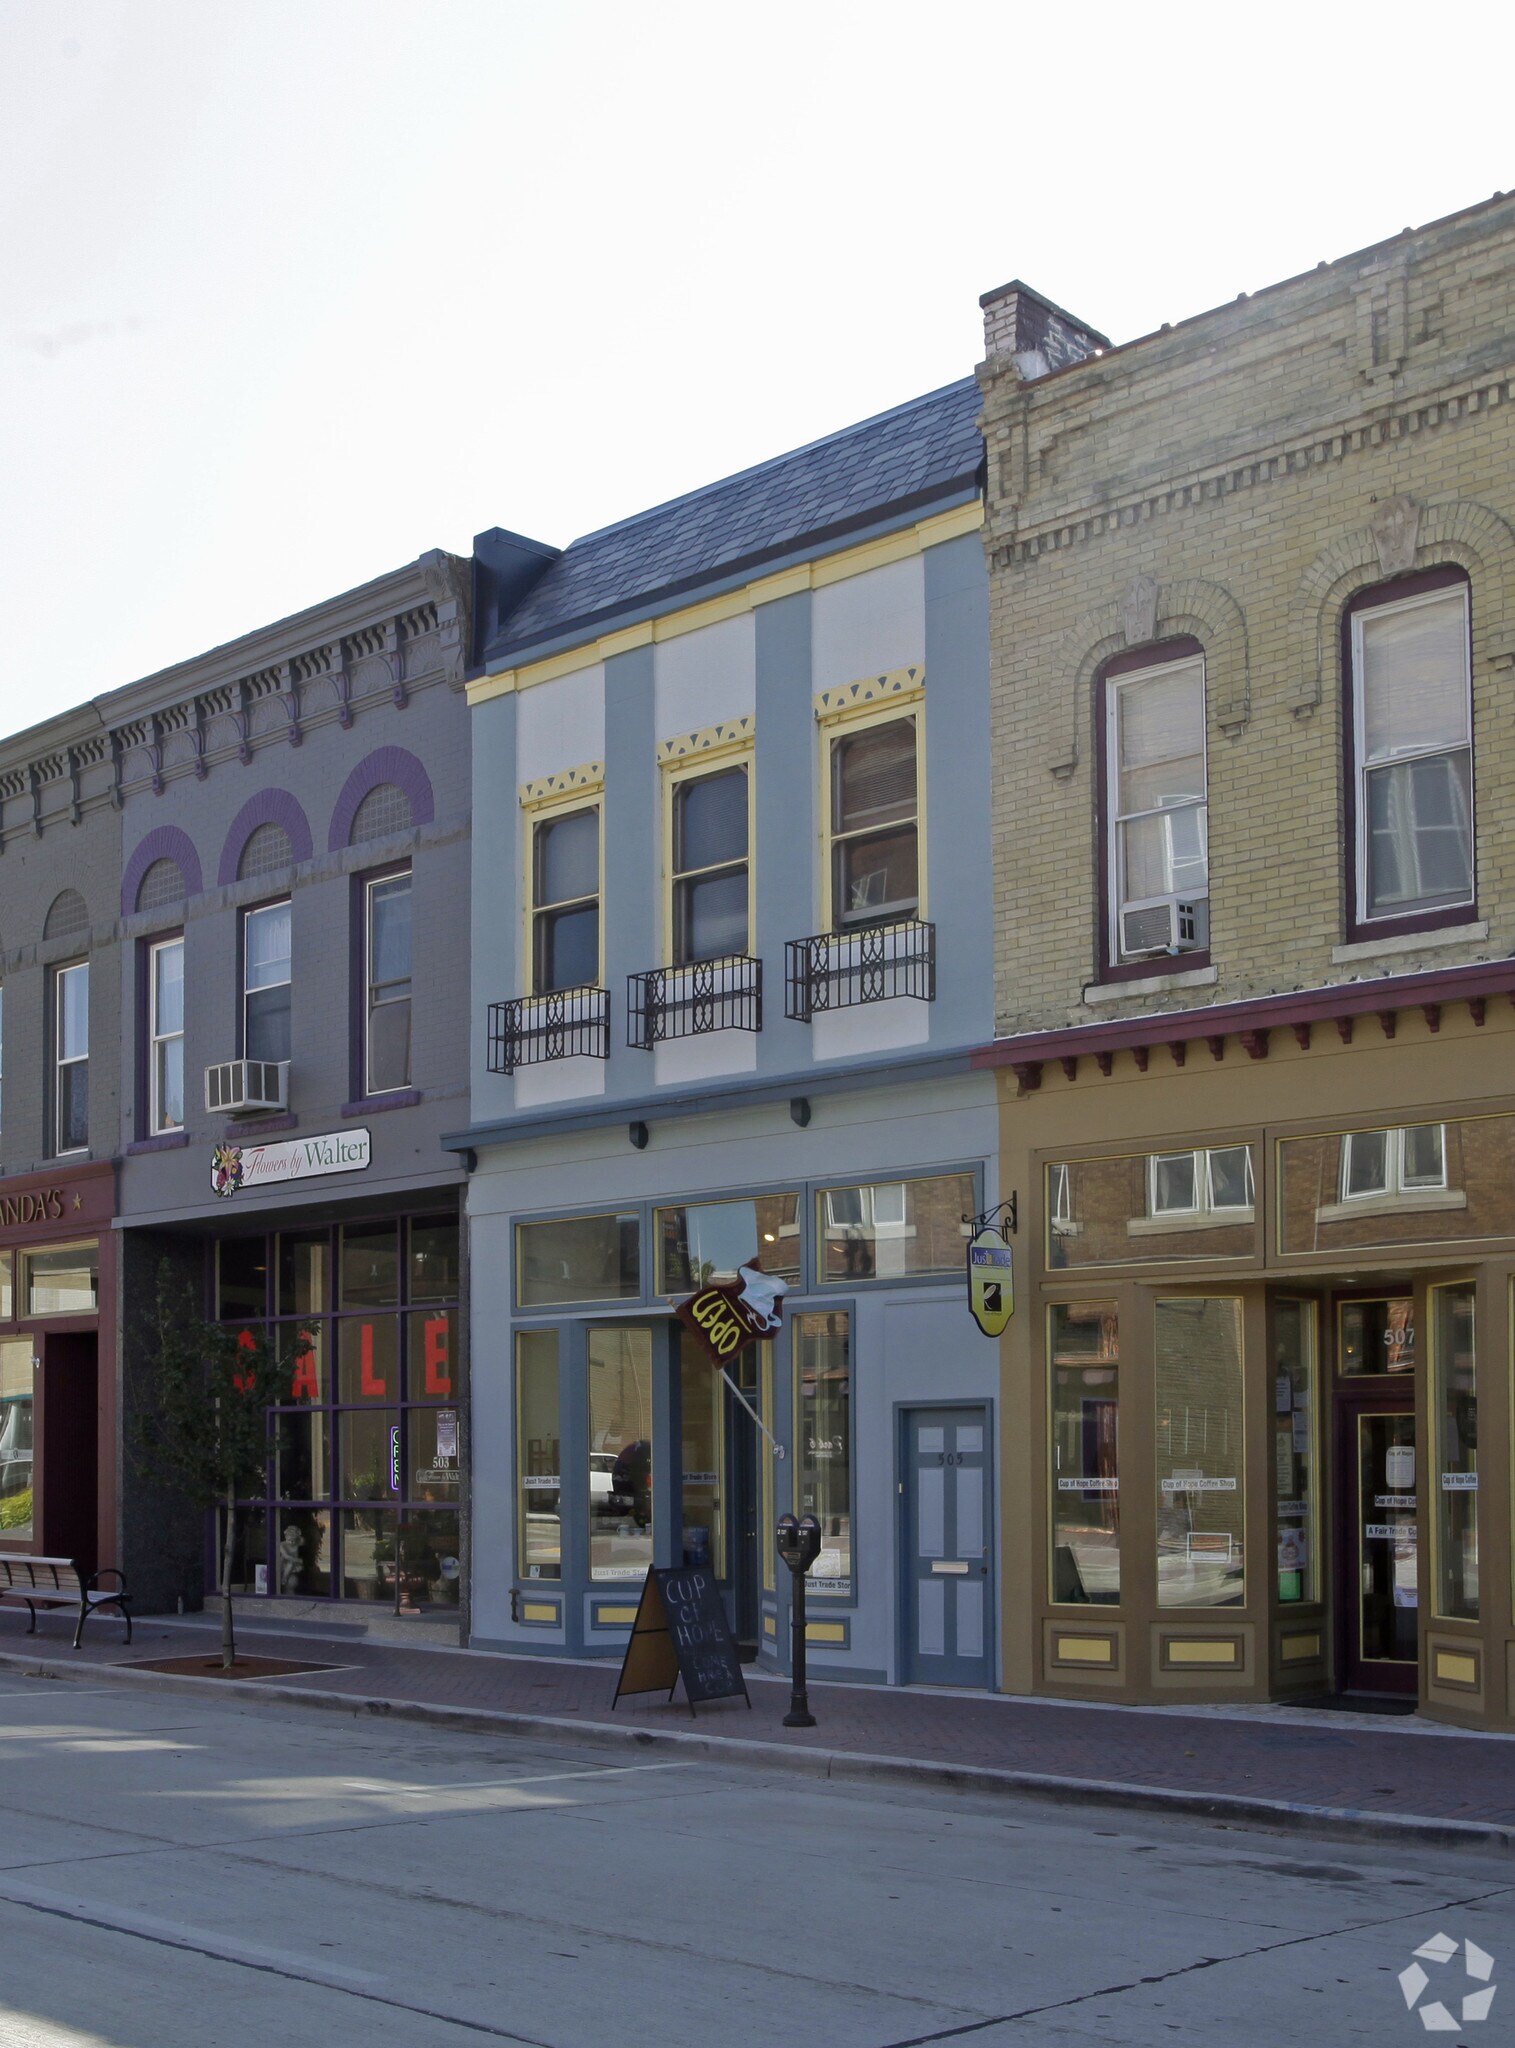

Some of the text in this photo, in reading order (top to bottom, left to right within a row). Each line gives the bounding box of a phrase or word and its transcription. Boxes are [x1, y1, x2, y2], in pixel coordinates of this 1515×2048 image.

[245, 1137, 368, 1180] Flowers by Walter
[1383, 1327, 1415, 1346] 507
[432, 1456, 450, 1469] 503
[937, 1452, 963, 1466] 505
[1162, 1479, 1235, 1488] Cup of Hope Coffee Shop
[1375, 1496, 1386, 1505] Cup
[1393, 1497, 1407, 1505] Hope
[1368, 1527, 1374, 1535] A
[1375, 1527, 1388, 1535] Fair
[1389, 1527, 1407, 1536] Trade
[666, 1574, 705, 1604] CUP
[818, 1581, 836, 1589] Trade
